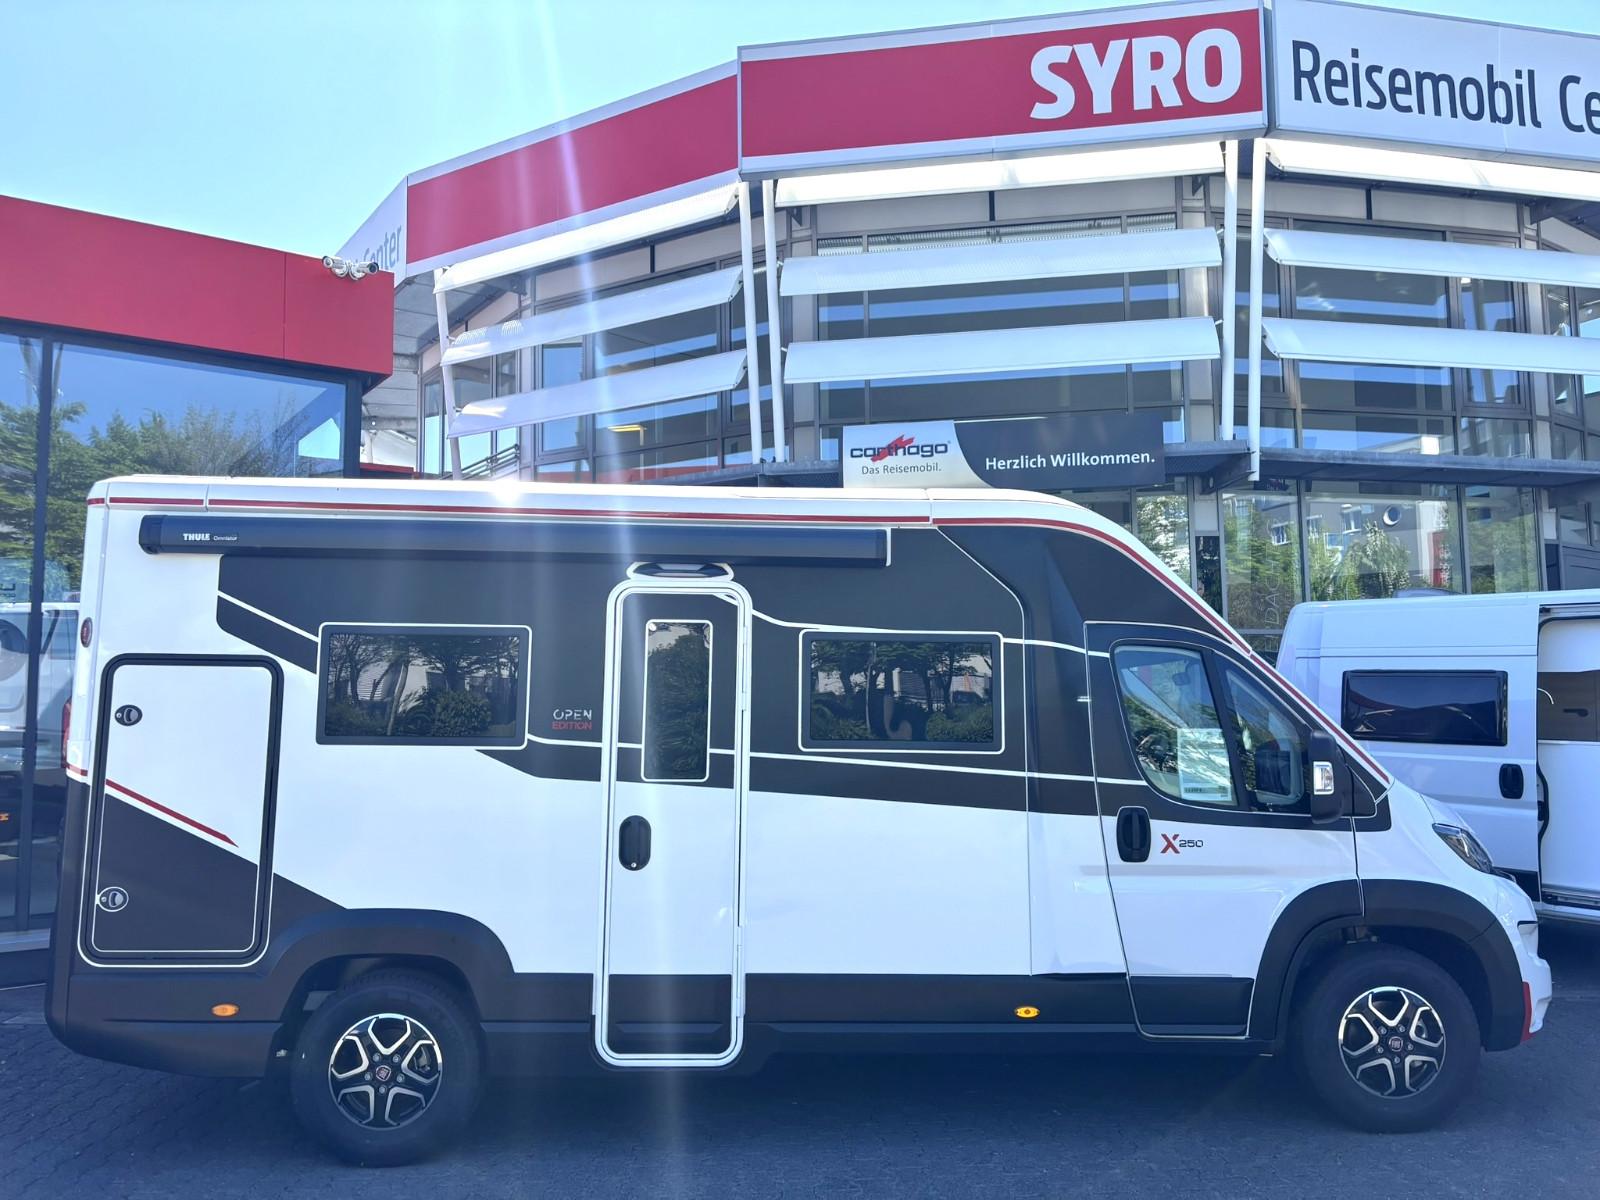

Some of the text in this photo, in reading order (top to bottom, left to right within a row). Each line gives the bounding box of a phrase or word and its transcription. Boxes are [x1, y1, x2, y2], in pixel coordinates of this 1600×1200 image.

[1030, 28, 1242, 120] SYRO
[1292, 39, 1542, 128] Reisemobil
[850, 441, 949, 460] carthago
[861, 462, 942, 475] Das Reisemobil.
[985, 451, 1156, 471] Herzlich Willkommen.
[553, 709, 592, 720] OPEN
[552, 721, 592, 730] EDITION
